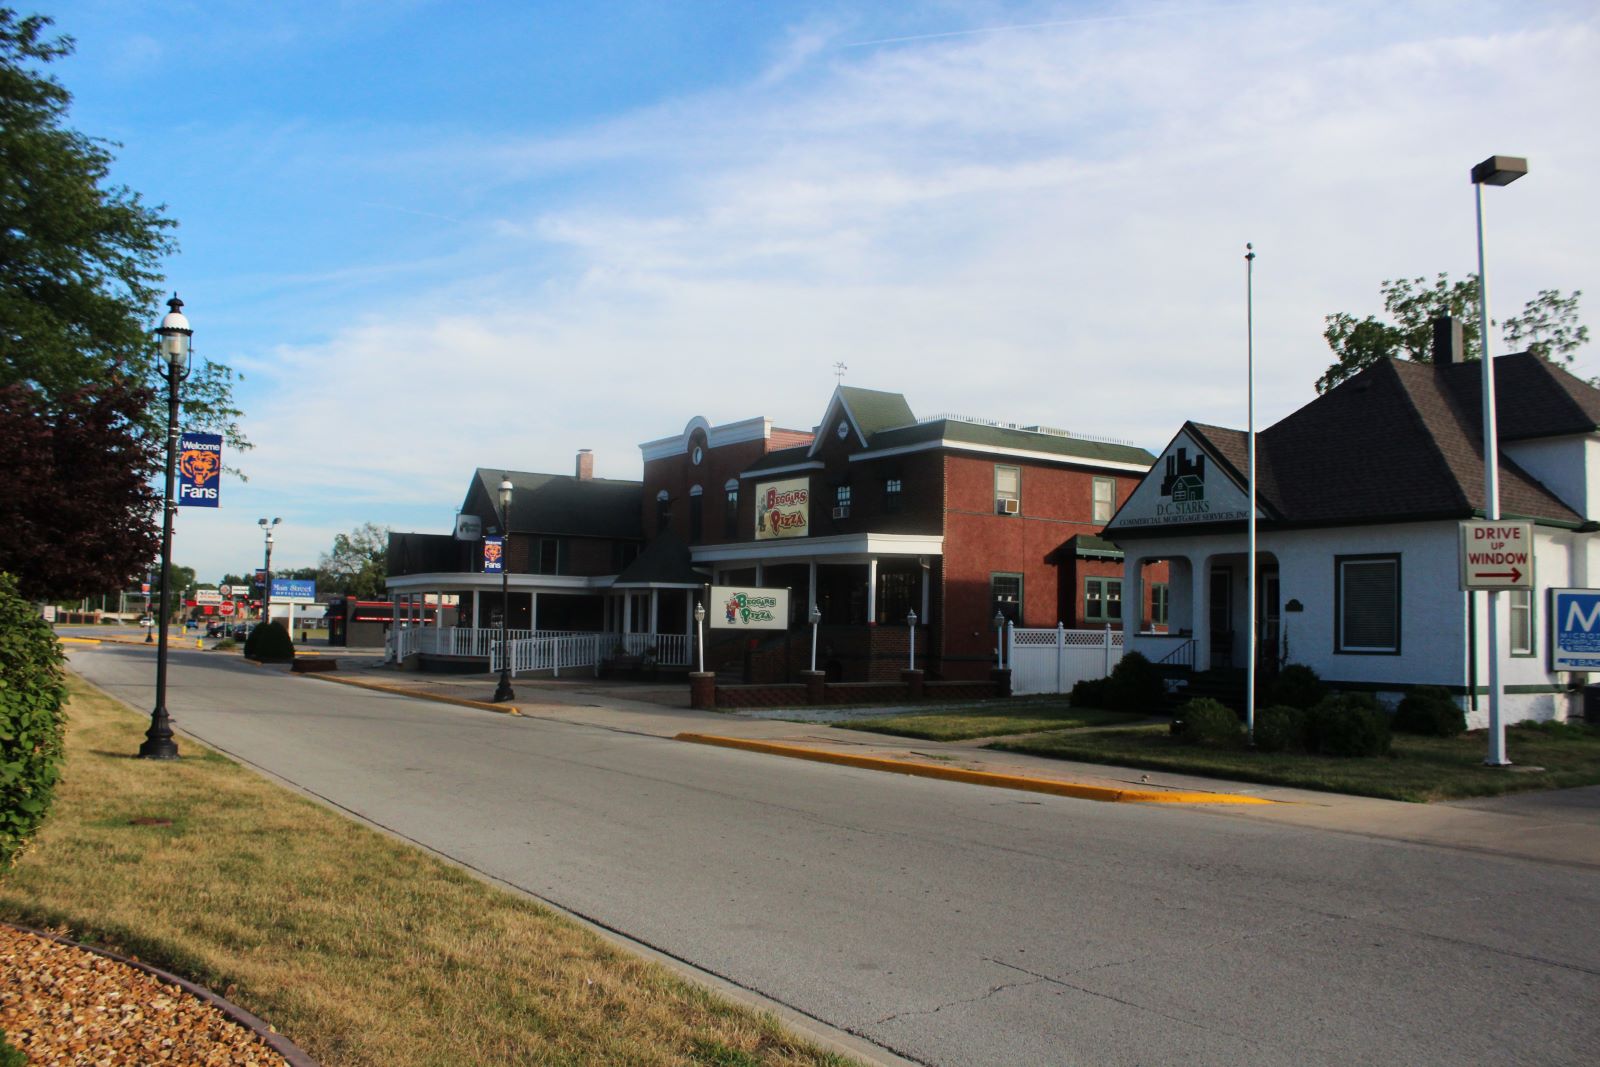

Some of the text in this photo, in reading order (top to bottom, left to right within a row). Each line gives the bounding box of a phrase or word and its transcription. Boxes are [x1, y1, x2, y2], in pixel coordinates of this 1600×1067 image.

[182, 440, 220, 451] Welcome
[181, 483, 217, 499] Fans
[766, 487, 808, 510] BEGGARS
[1175, 500, 1210, 515] STARKS
[770, 508, 806, 536] PIZZA
[1120, 518, 1161, 526] COMMERCIAL
[1474, 527, 1521, 540] DRIVE
[1490, 542, 1505, 550] UP
[1468, 552, 1528, 565] WINDOW
[736, 592, 776, 607] BEGGARS
[740, 607, 774, 624] PIZZA
